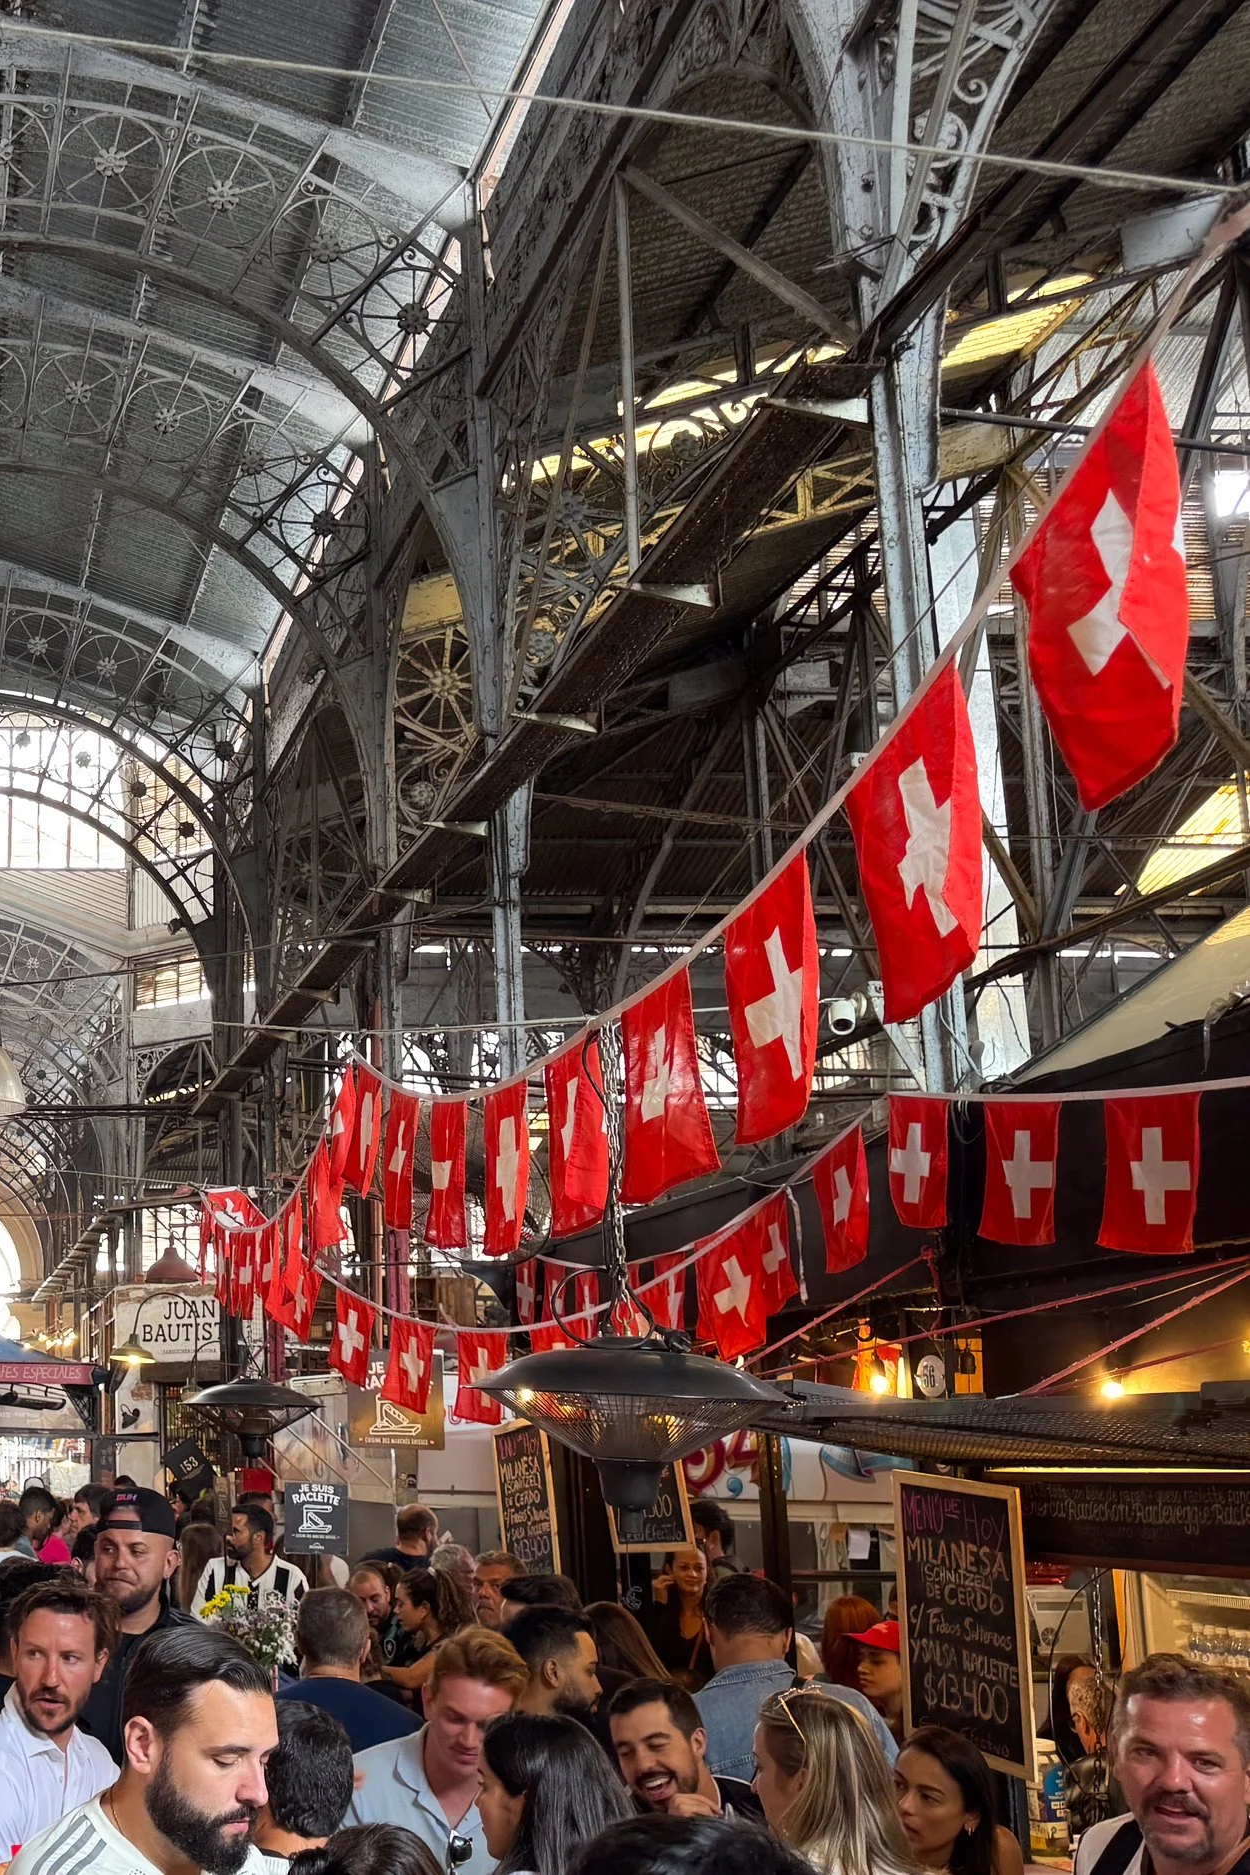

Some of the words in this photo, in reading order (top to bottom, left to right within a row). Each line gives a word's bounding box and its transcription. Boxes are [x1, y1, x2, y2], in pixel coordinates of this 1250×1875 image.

[163, 1299, 216, 1320] JUAN
[22, 1365, 82, 1381] ESPECIALES
[367, 1361, 385, 1375] JE
[179, 1456, 199, 1474] 153
[499, 1456, 541, 1483] MILANESA
[291, 1492, 341, 1506] RACLETTE
[298, 1483, 310, 1493] JE
[311, 1483, 335, 1494] SUIS
[963, 1499, 1005, 1553] HOY
[906, 1536, 1009, 1582] MILANESA
[926, 1581, 942, 1599] DE
[944, 1583, 1004, 1615] CERDO
[962, 1648, 1020, 1688] RACLETTE
